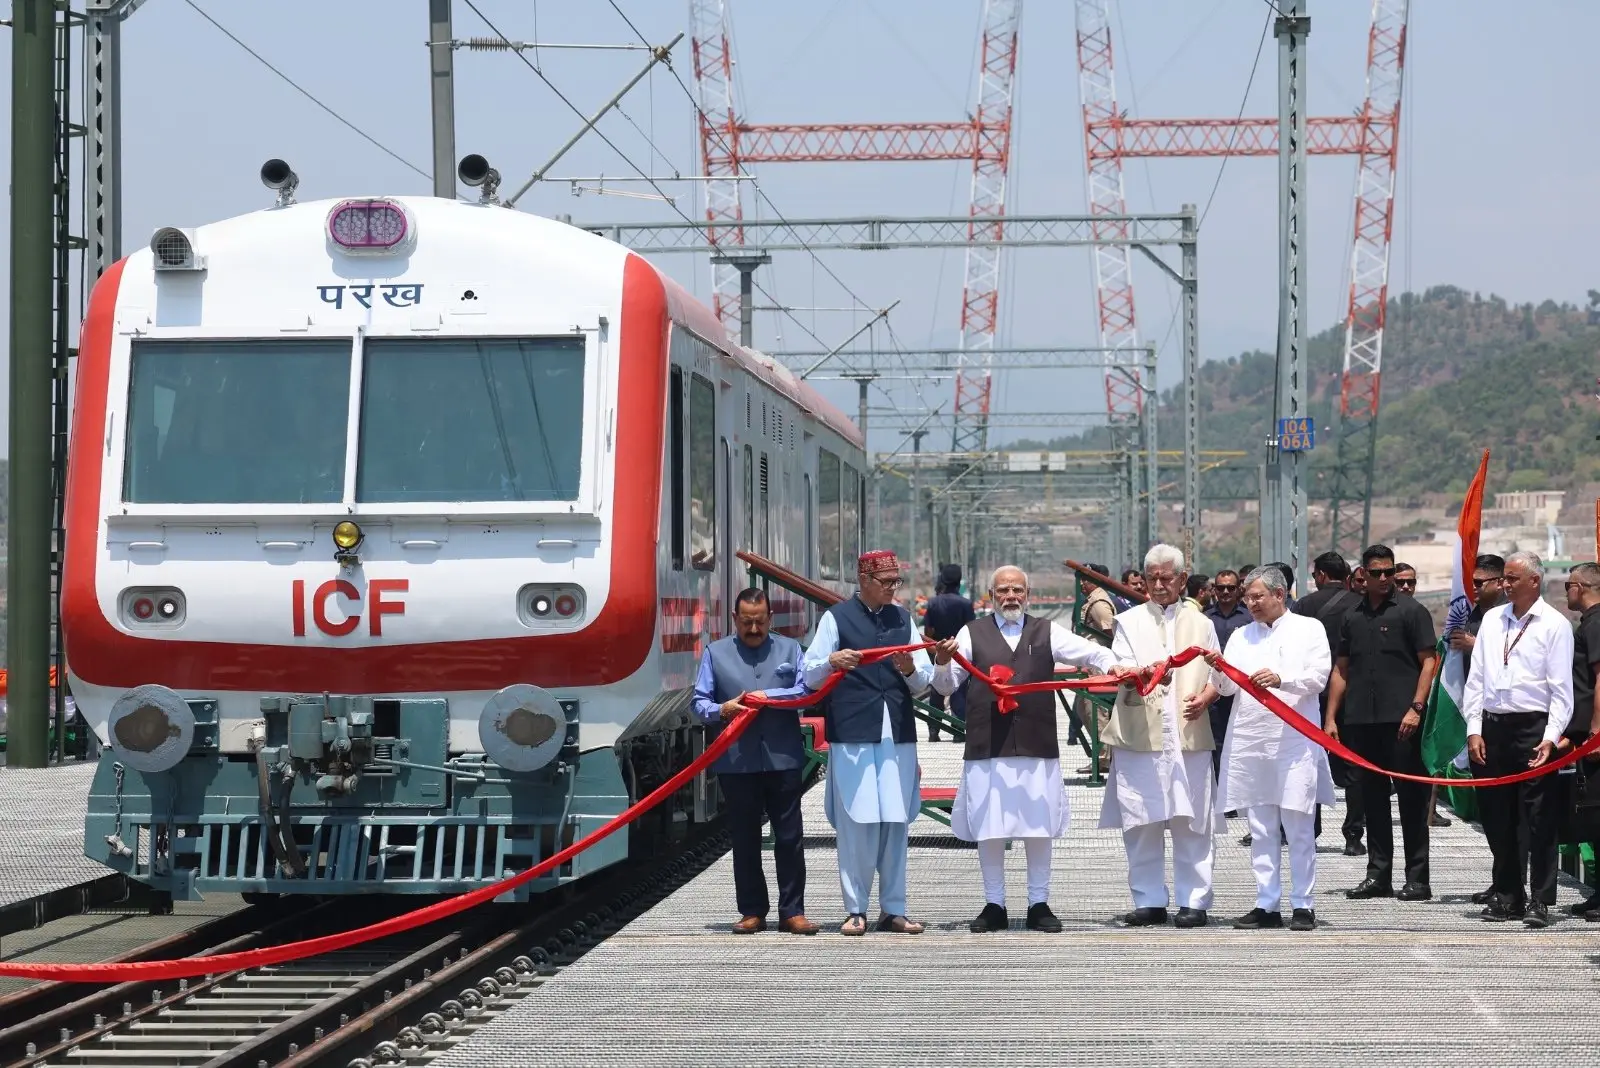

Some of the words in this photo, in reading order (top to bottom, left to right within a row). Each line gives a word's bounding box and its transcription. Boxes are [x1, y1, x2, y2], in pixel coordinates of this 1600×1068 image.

[316, 284, 424, 309] परख
[1284, 420, 1307, 434] 104
[1282, 434, 1310, 449] 06A
[293, 579, 409, 636] ICF
